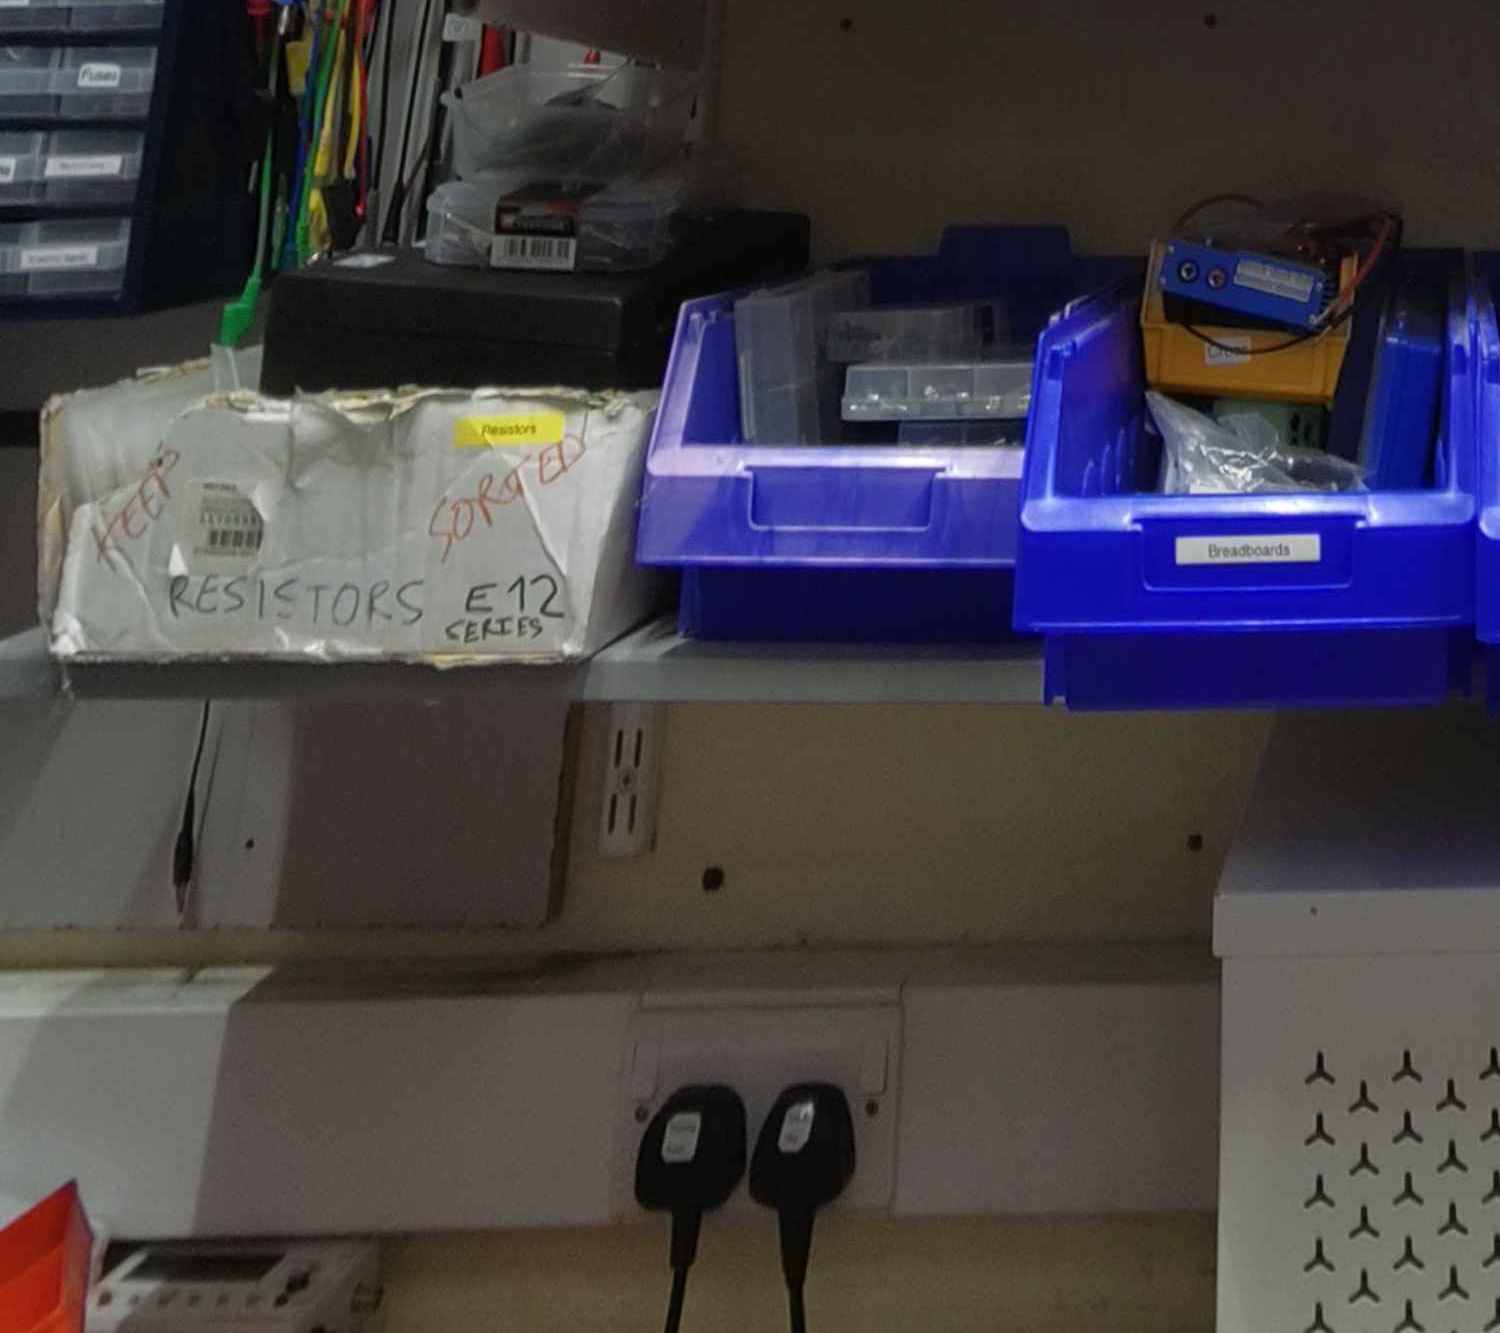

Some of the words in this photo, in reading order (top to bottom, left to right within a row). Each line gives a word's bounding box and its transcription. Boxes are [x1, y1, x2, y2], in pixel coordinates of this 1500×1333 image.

[82, 68, 117, 84] Fuses
[480, 422, 537, 437] Resistors
[426, 416, 589, 566] SORTED
[1206, 542, 1291, 560] Breadboards
[169, 574, 425, 628] RESISTORS
[464, 574, 566, 619] E12
[444, 617, 544, 645] SERIES
